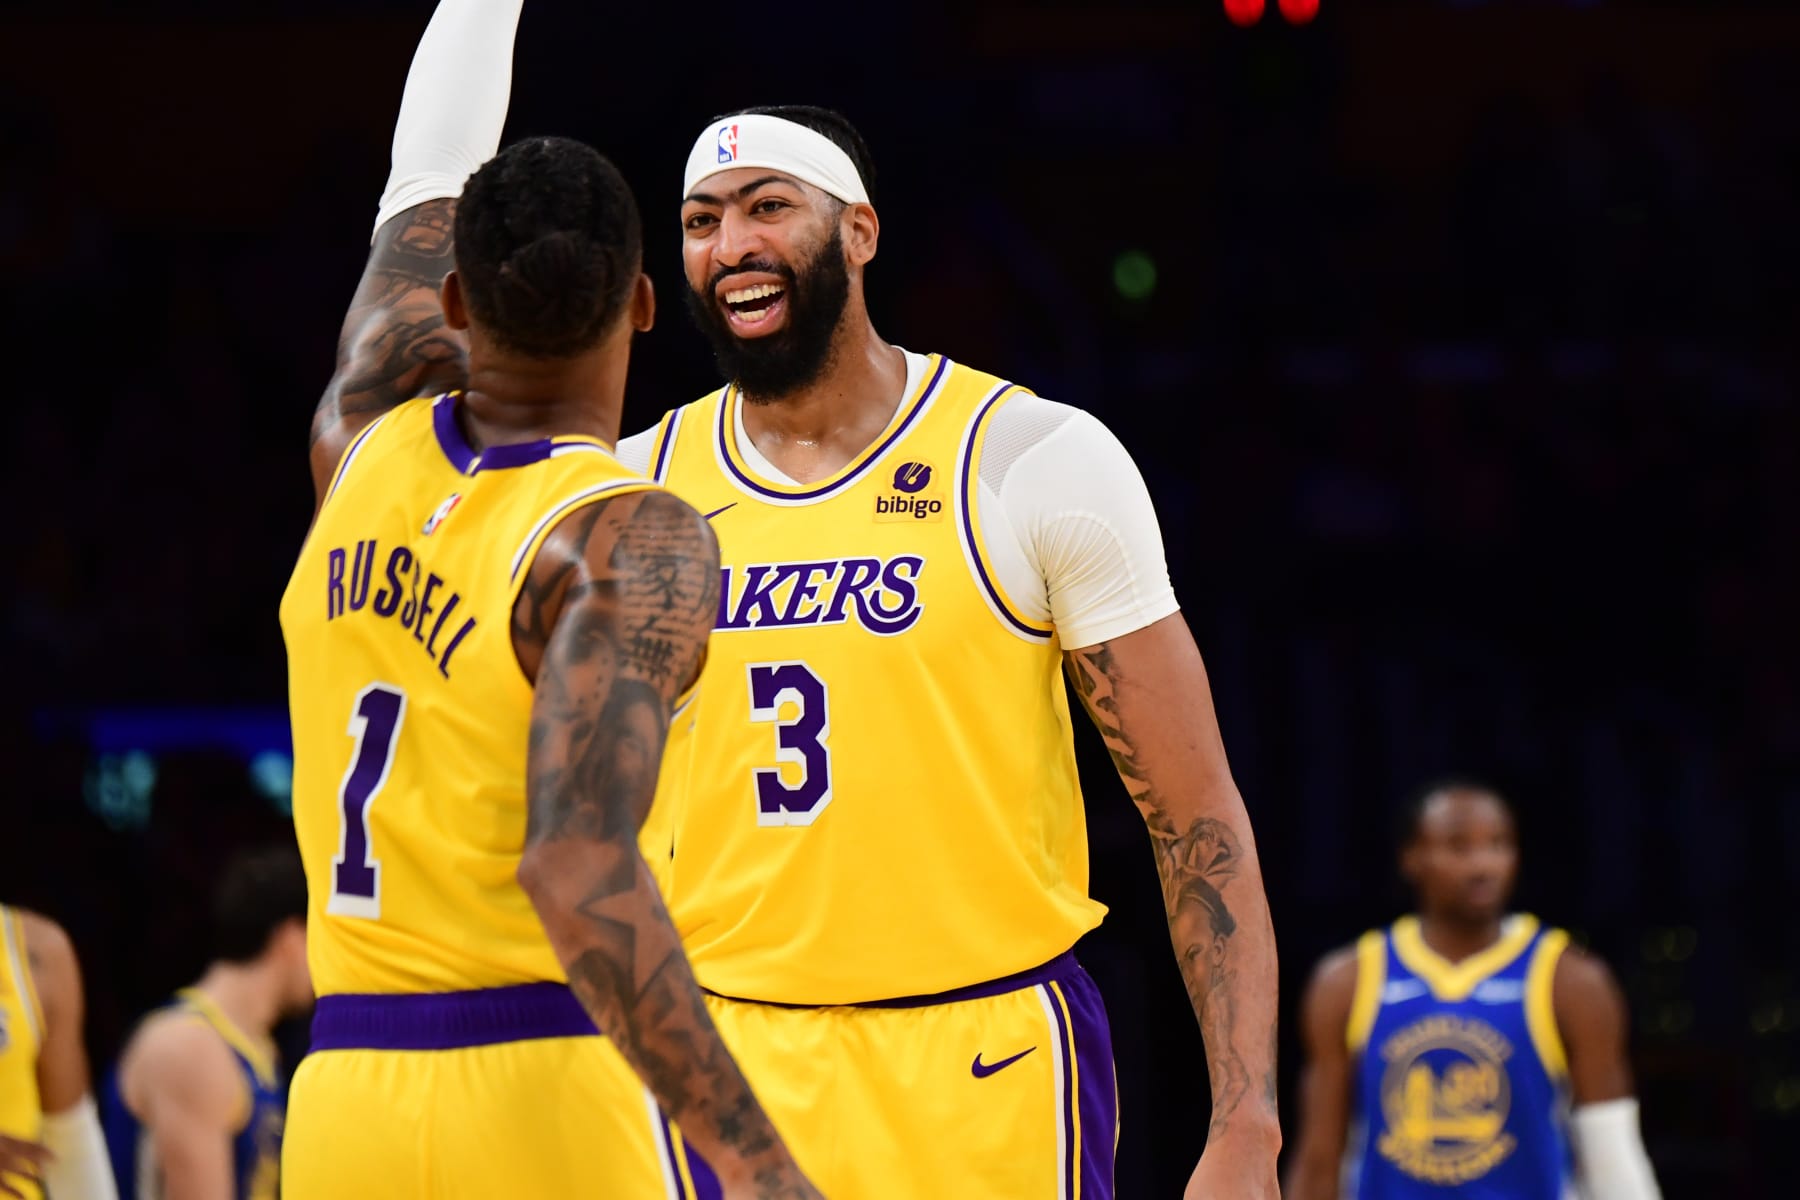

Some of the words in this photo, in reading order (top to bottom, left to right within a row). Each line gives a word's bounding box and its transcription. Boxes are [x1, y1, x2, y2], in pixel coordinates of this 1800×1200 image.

[876, 496, 942, 519] bibigo
[328, 540, 476, 679] RUSSELL
[326, 681, 407, 919] 1
[746, 659, 833, 827] 3
